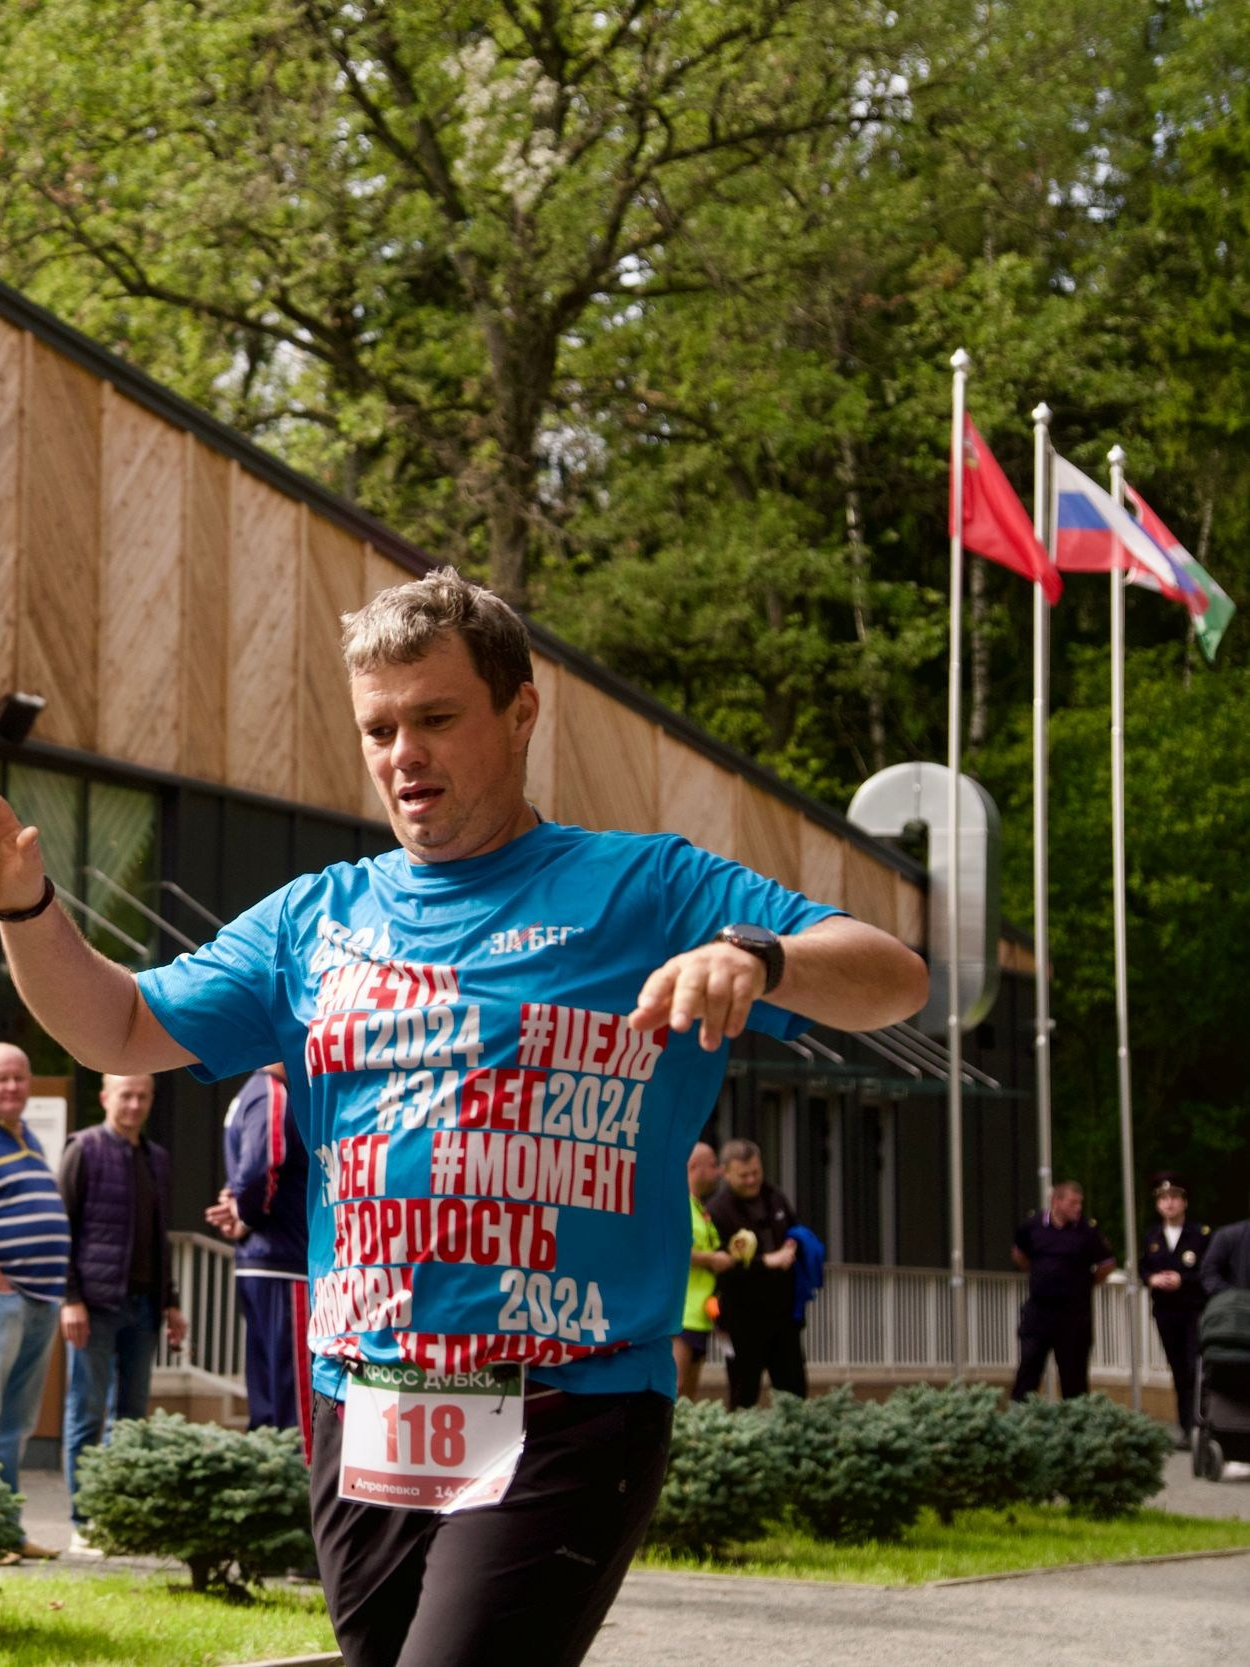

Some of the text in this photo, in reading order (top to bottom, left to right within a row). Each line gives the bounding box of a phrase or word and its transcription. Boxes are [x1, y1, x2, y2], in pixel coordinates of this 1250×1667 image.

[375, 1068, 646, 1147] #ЗАБЕГ2024
[430, 1130, 637, 1216] #МОМЕНТ
[498, 1269, 610, 1343] 2024
[362, 1362, 419, 1386] КРОСС
[382, 1402, 466, 1468] 118
[355, 1477, 421, 1498] Апрелевка
